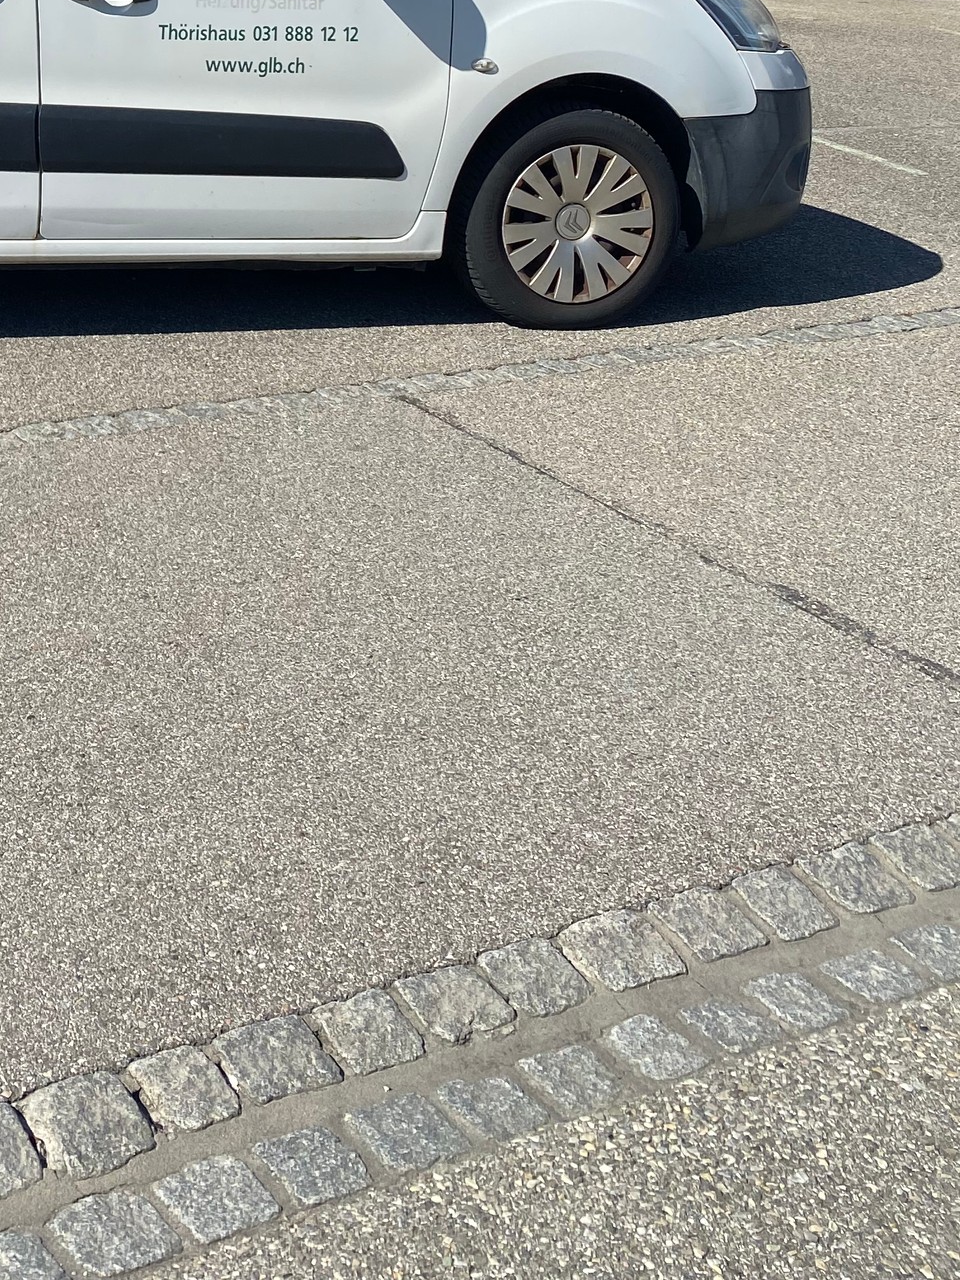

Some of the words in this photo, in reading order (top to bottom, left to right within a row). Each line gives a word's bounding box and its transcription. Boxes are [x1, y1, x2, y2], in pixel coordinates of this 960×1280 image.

[158, 24, 246, 42] Thörishaus
[253, 26, 278, 42] 031
[285, 26, 314, 42] 888
[321, 26, 336, 42] 12
[343, 26, 359, 42] 12
[205, 57, 306, 78] www.glb.ch
